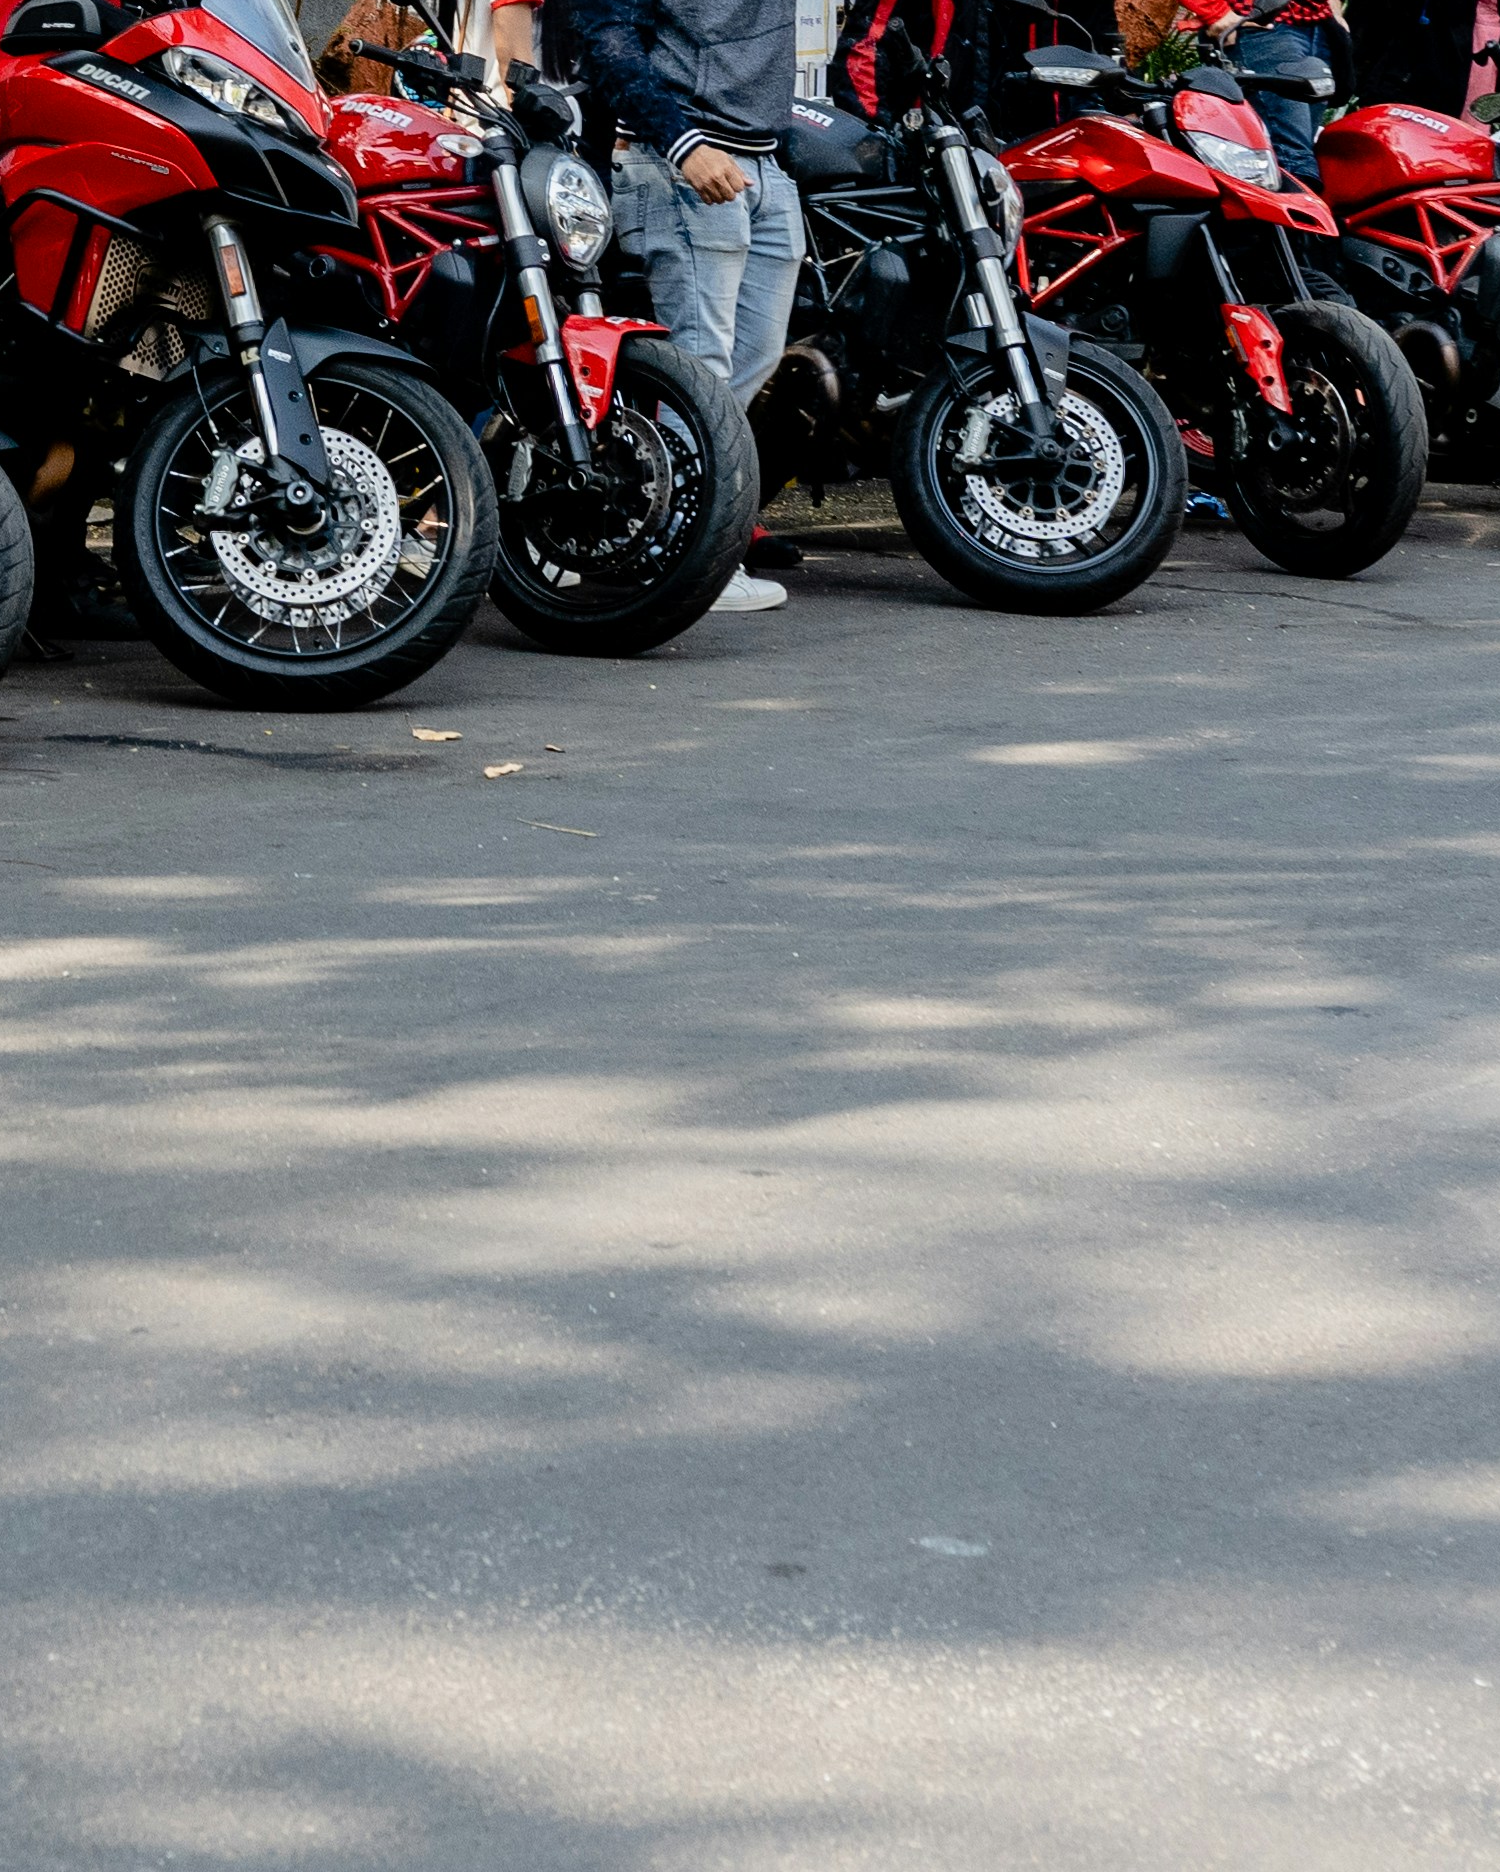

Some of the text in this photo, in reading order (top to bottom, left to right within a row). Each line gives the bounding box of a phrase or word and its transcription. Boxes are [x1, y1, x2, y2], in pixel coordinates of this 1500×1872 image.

[77, 62, 151, 101] DUCATI
[339, 99, 414, 129] DUCATI
[1388, 107, 1450, 134] DUCATI
[209, 464, 230, 503] brembo
